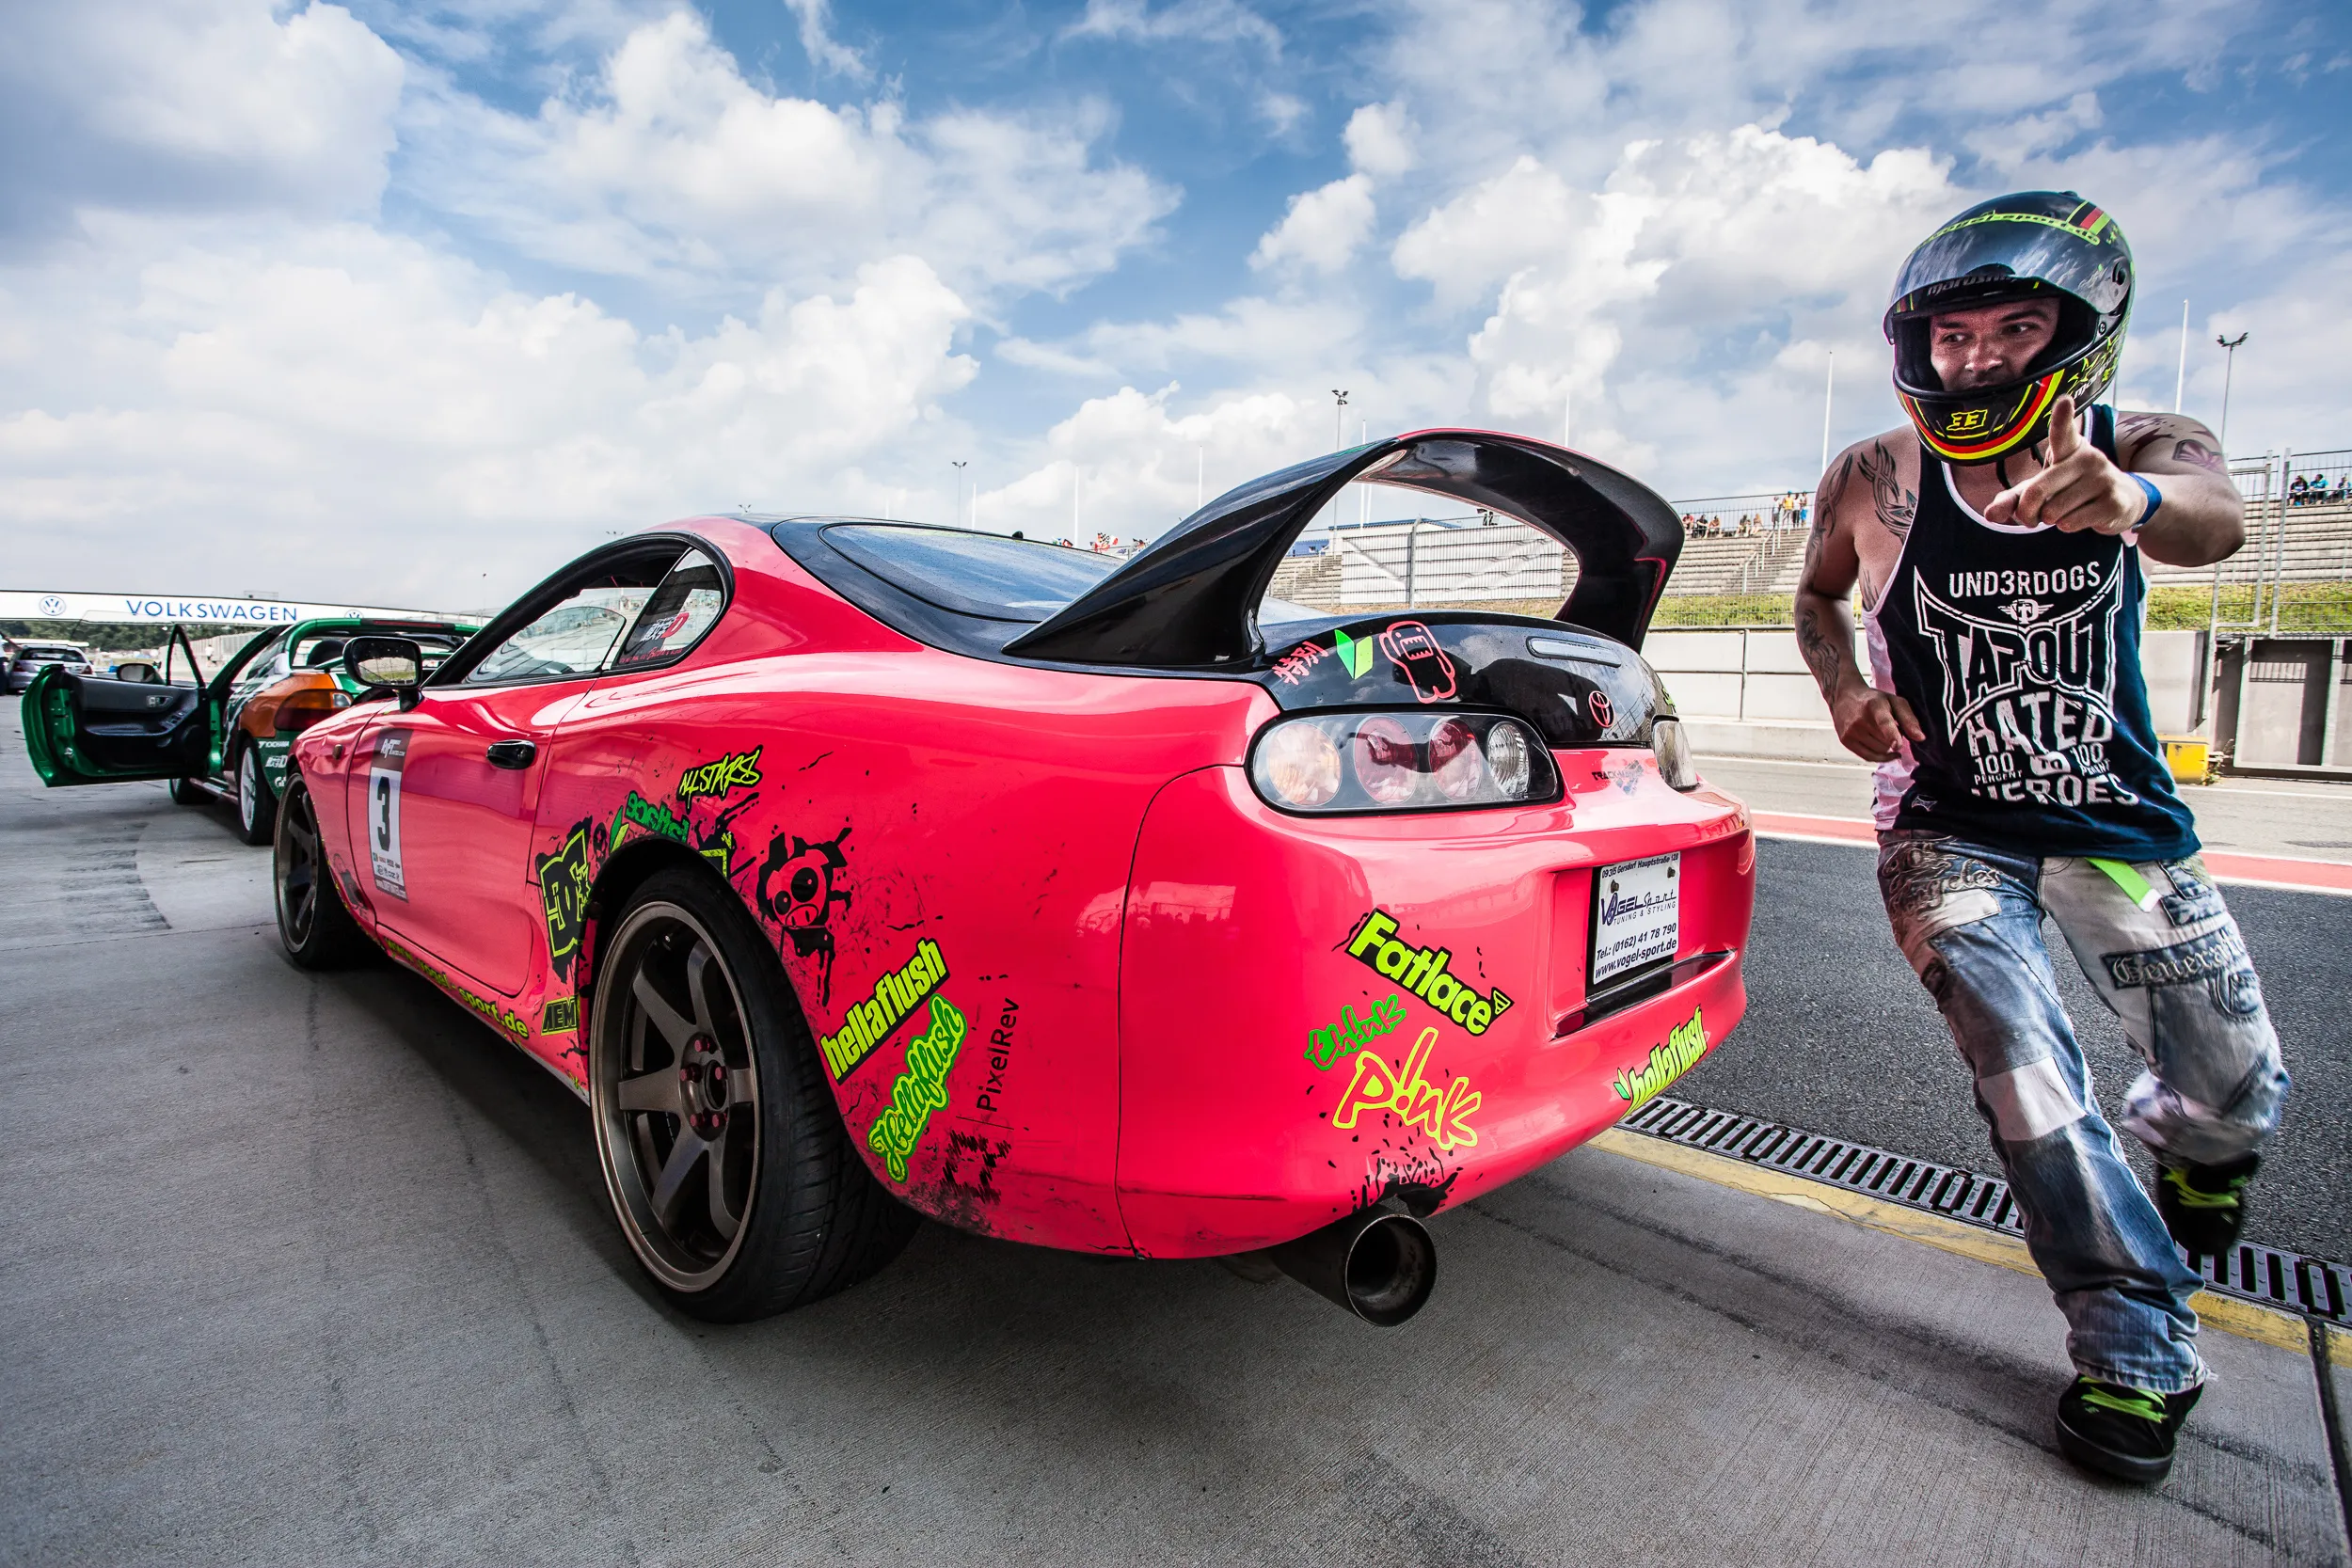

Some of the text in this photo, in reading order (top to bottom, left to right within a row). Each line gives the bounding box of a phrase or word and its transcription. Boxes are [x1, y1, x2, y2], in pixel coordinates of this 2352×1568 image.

[1949, 562, 2100, 598] UND3RDOGS
[126, 599, 297, 622] VOLKSWAGEN
[1272, 641, 1328, 685] 特別
[1966, 691, 2113, 756] HATED
[1975, 752, 2014, 775] 100
[2070, 742, 2104, 767] 100
[376, 776, 390, 852] 3
[1638, 855, 1670, 869] Hauptstraße
[1647, 900, 1677, 915] STYLING
[1595, 938, 1677, 978] www.vogel-sport.de
[1597, 923, 1677, 960] Tel.: (0162) 41 78 790
[1349, 911, 1492, 1035] Fatlace
[820, 940, 947, 1081] hellaflush
[977, 998, 1019, 1112] PixelRev
[1619, 1005, 1708, 1120] hellaflush
